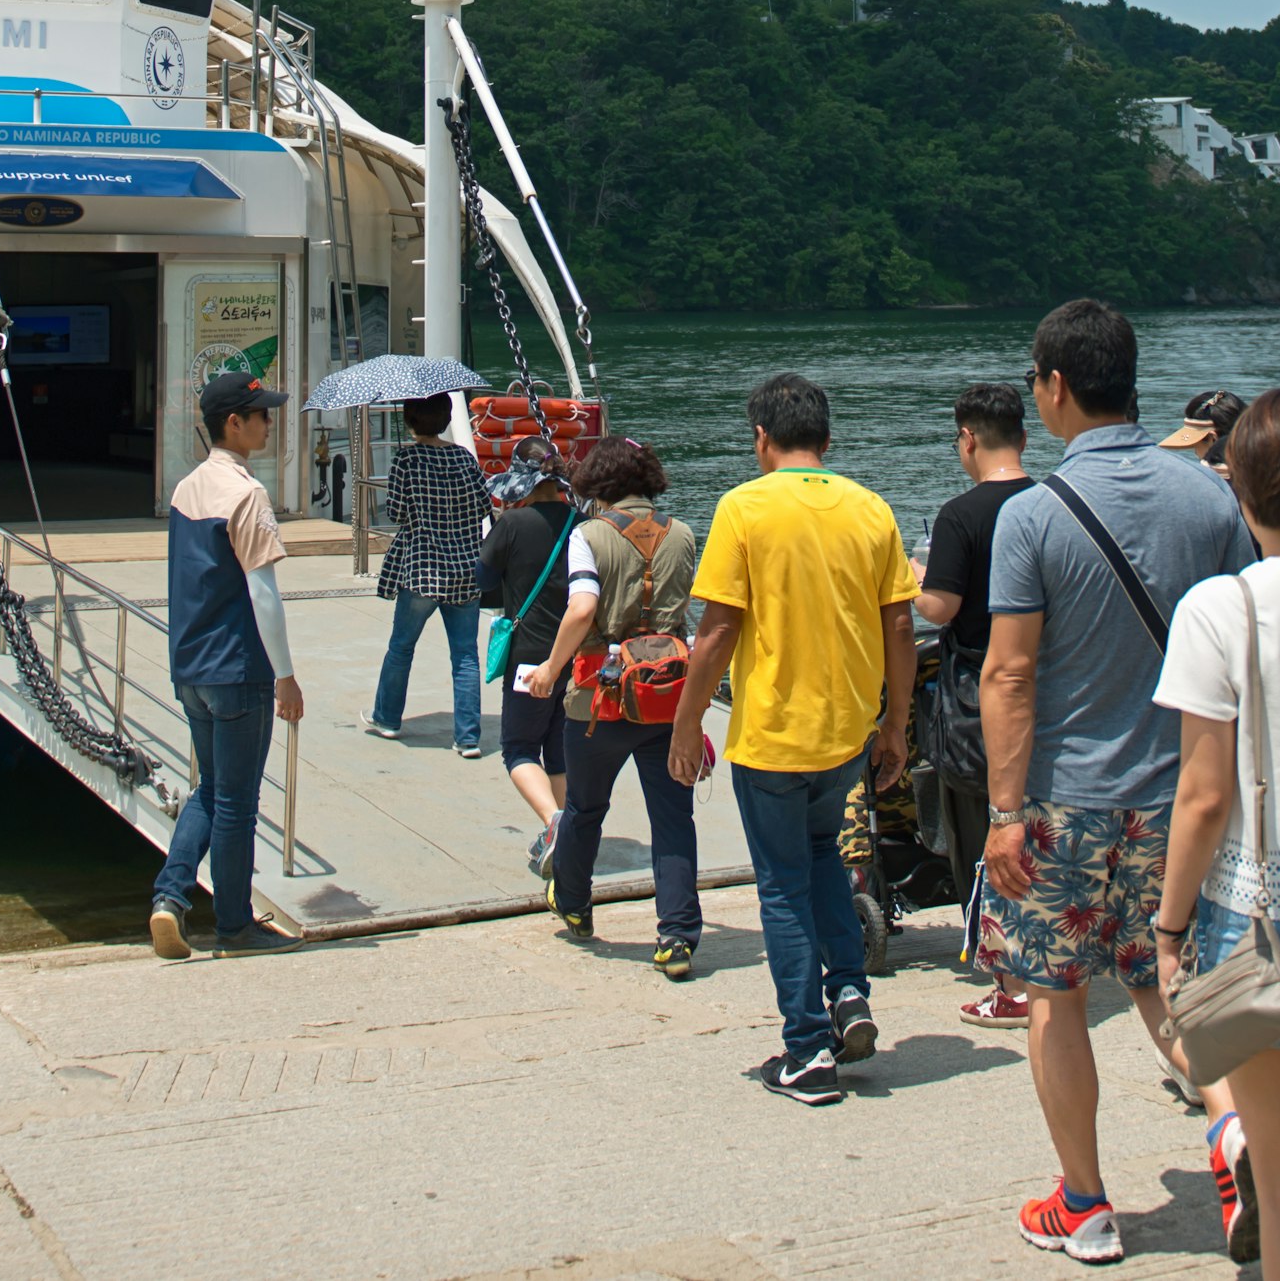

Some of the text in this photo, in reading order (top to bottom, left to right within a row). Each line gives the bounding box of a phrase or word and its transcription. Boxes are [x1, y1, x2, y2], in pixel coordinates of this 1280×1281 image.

[13, 129, 92, 144] NAMINARA
[95, 130, 162, 145] REPUBLIC
[75, 173, 132, 184] unicef
[205, 346, 242, 361] REPUBLIC
[843, 989, 857, 997] NIKE
